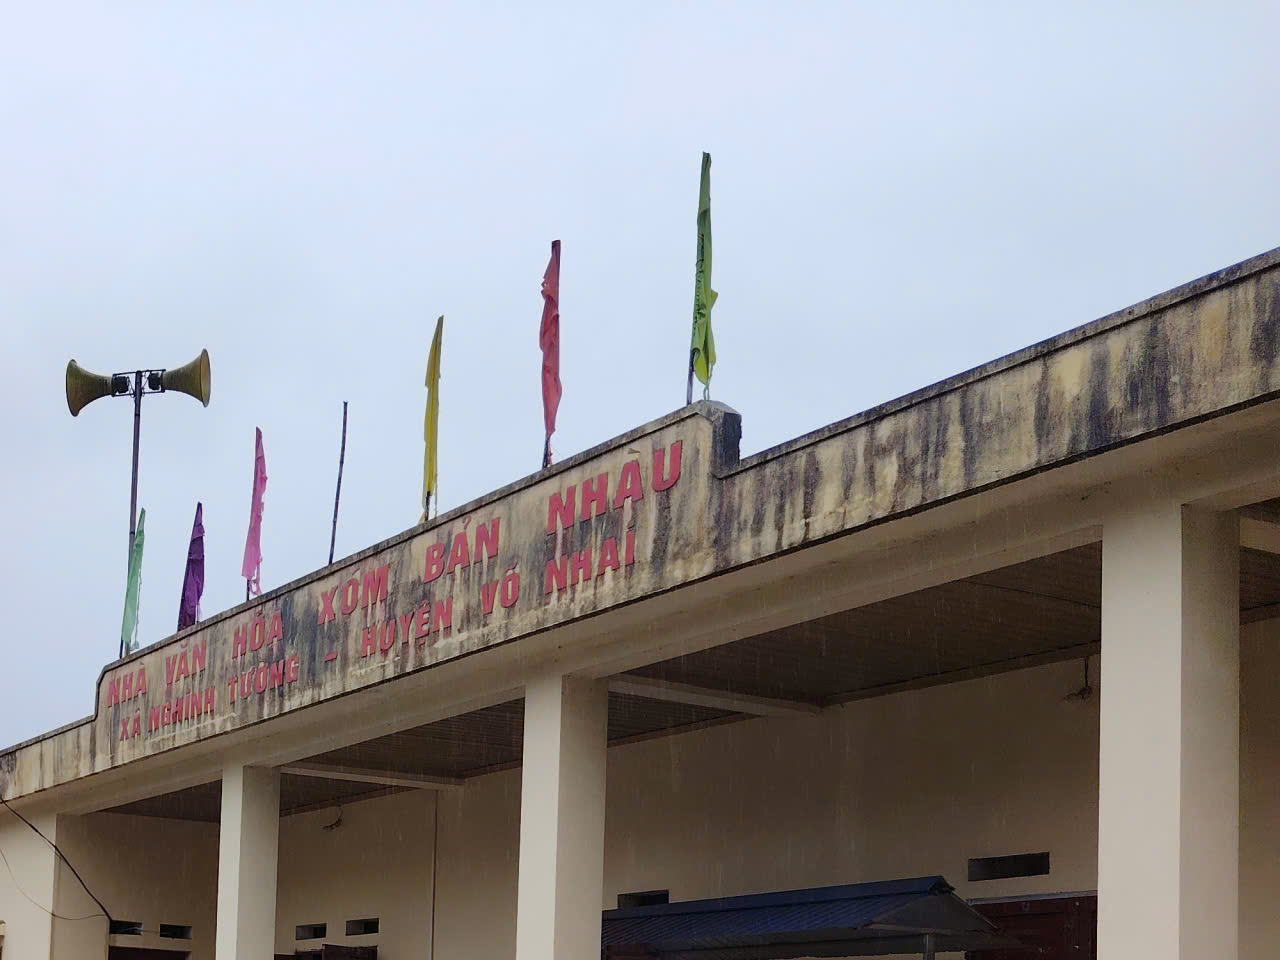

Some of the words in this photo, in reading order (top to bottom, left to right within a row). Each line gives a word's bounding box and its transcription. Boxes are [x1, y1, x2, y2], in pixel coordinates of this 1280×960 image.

[166, 640, 207, 685] VĂN
[317, 566, 389, 625] XÓM
[424, 516, 501, 584] BẢN
[546, 440, 683, 536] NHÀU
[481, 561, 519, 615] VÕ
